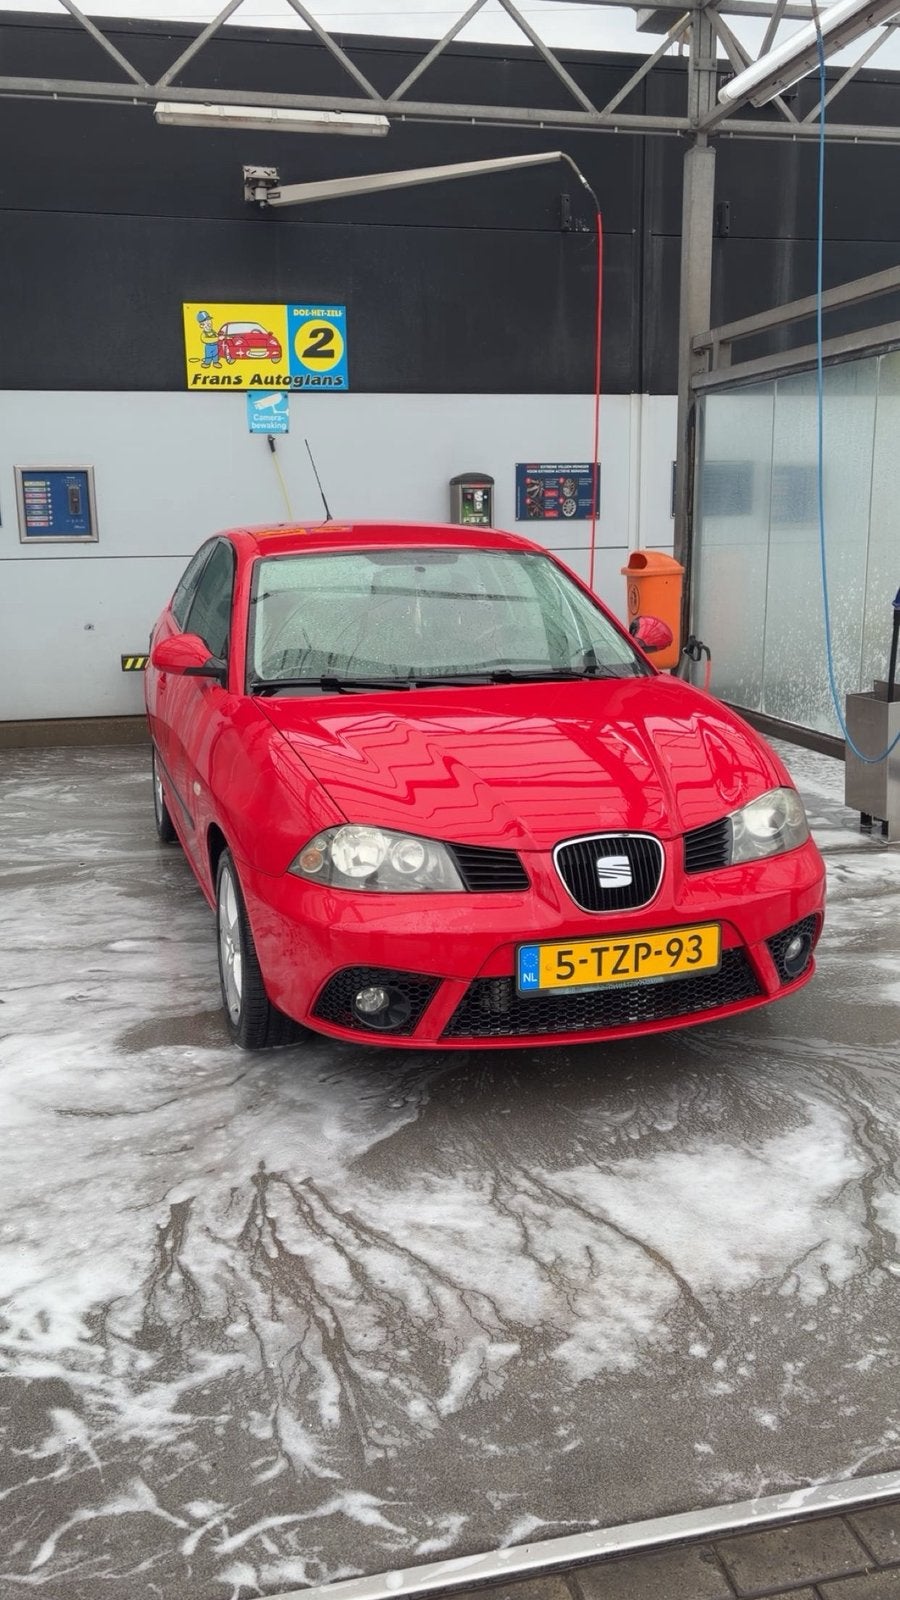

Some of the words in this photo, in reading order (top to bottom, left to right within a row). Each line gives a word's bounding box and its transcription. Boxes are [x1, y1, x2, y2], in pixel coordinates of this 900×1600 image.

[302, 327, 335, 358] 2
[191, 373, 243, 385] Frans
[250, 373, 343, 388] Autoglans
[251, 421, 287, 430] bewaking
[556, 934, 703, 980] 5-TZP-93
[523, 973, 538, 983] NL
